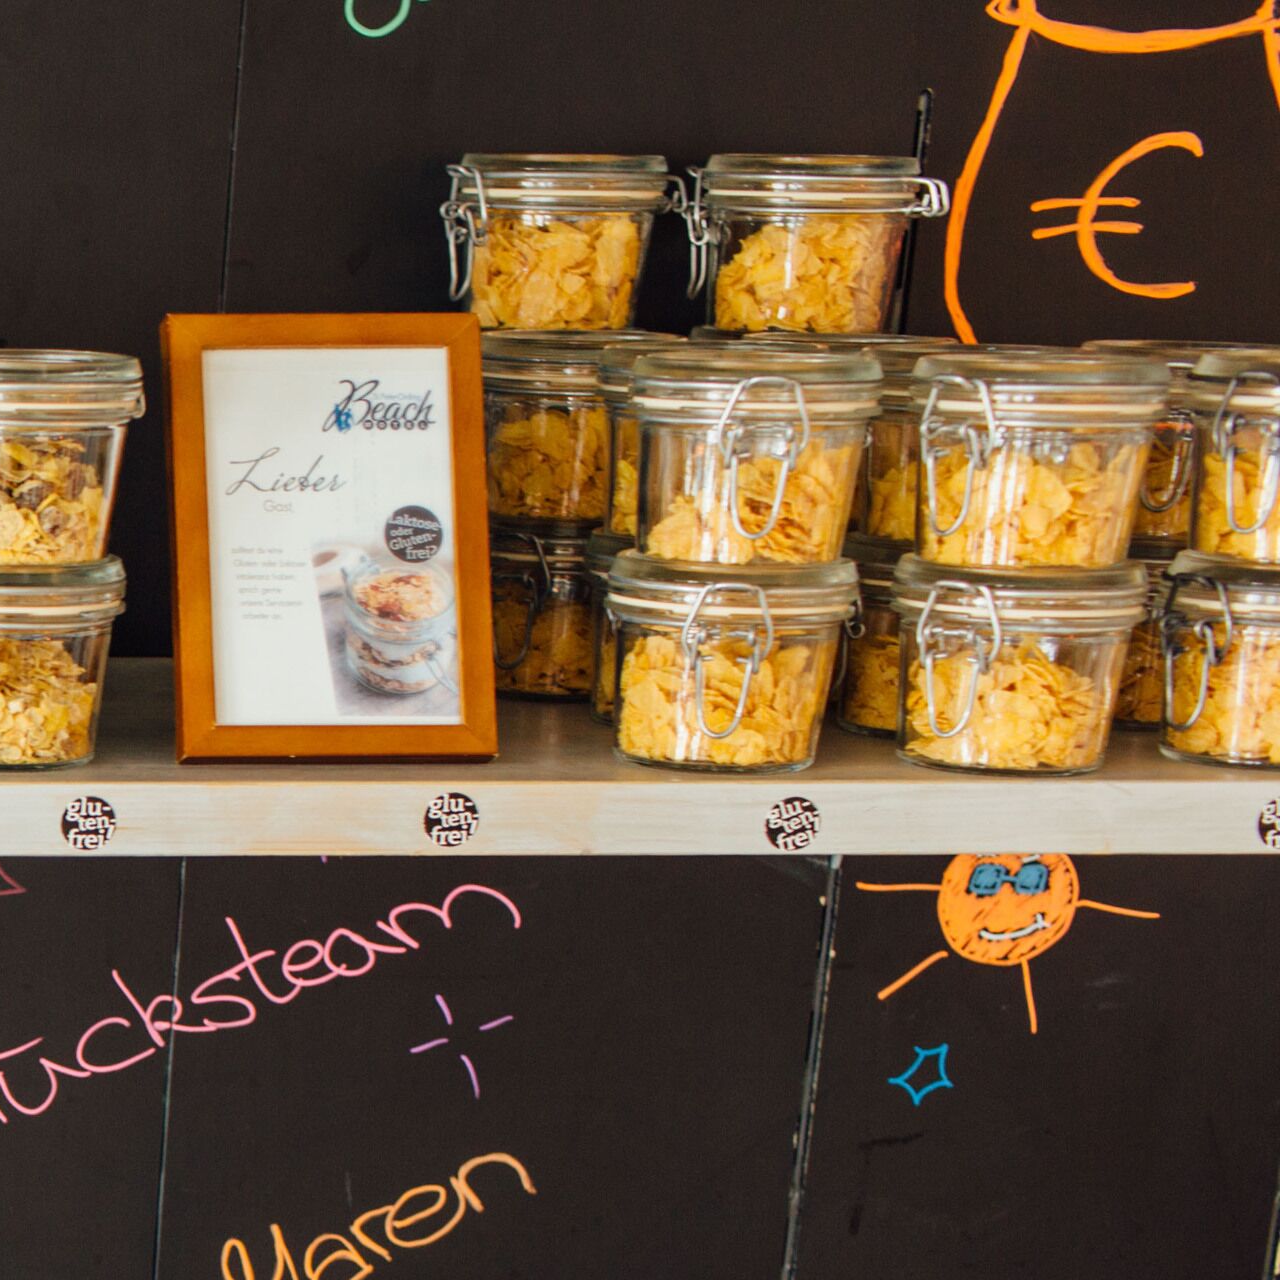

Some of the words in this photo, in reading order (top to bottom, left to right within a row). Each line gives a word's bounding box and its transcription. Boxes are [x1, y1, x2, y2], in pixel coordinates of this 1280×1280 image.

[322, 379, 437, 432] Beach
[225, 447, 348, 496] Lieber
[65, 797, 112, 821] glu-
[427, 794, 474, 819] glu-
[767, 801, 811, 829] glu-
